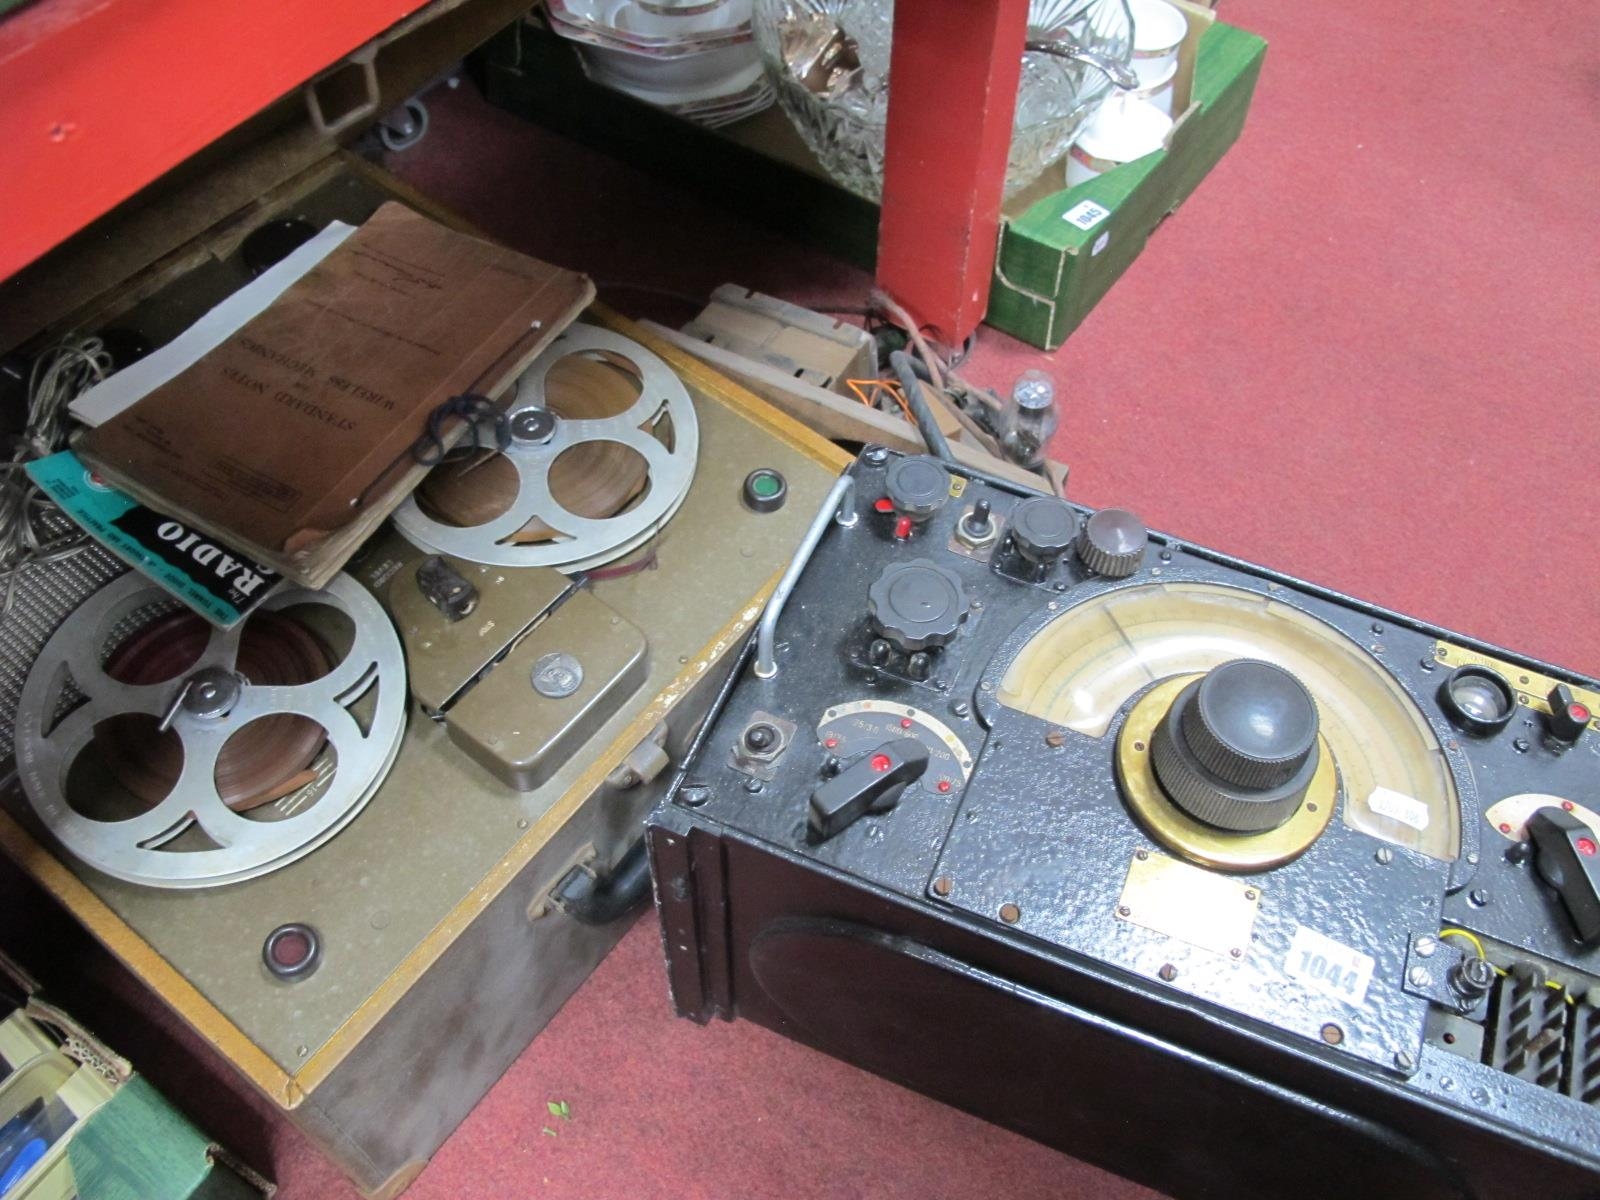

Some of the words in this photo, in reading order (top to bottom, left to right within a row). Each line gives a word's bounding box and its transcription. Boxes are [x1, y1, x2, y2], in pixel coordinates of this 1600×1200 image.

[1076, 207, 1102, 225] 1045
[220, 367, 269, 394] NOTES
[328, 375, 395, 411] WIRELESS
[274, 390, 356, 431] STANDARD
[157, 521, 265, 598] RADIO
[226, 589, 244, 605] The
[1300, 950, 1359, 996] 1044
